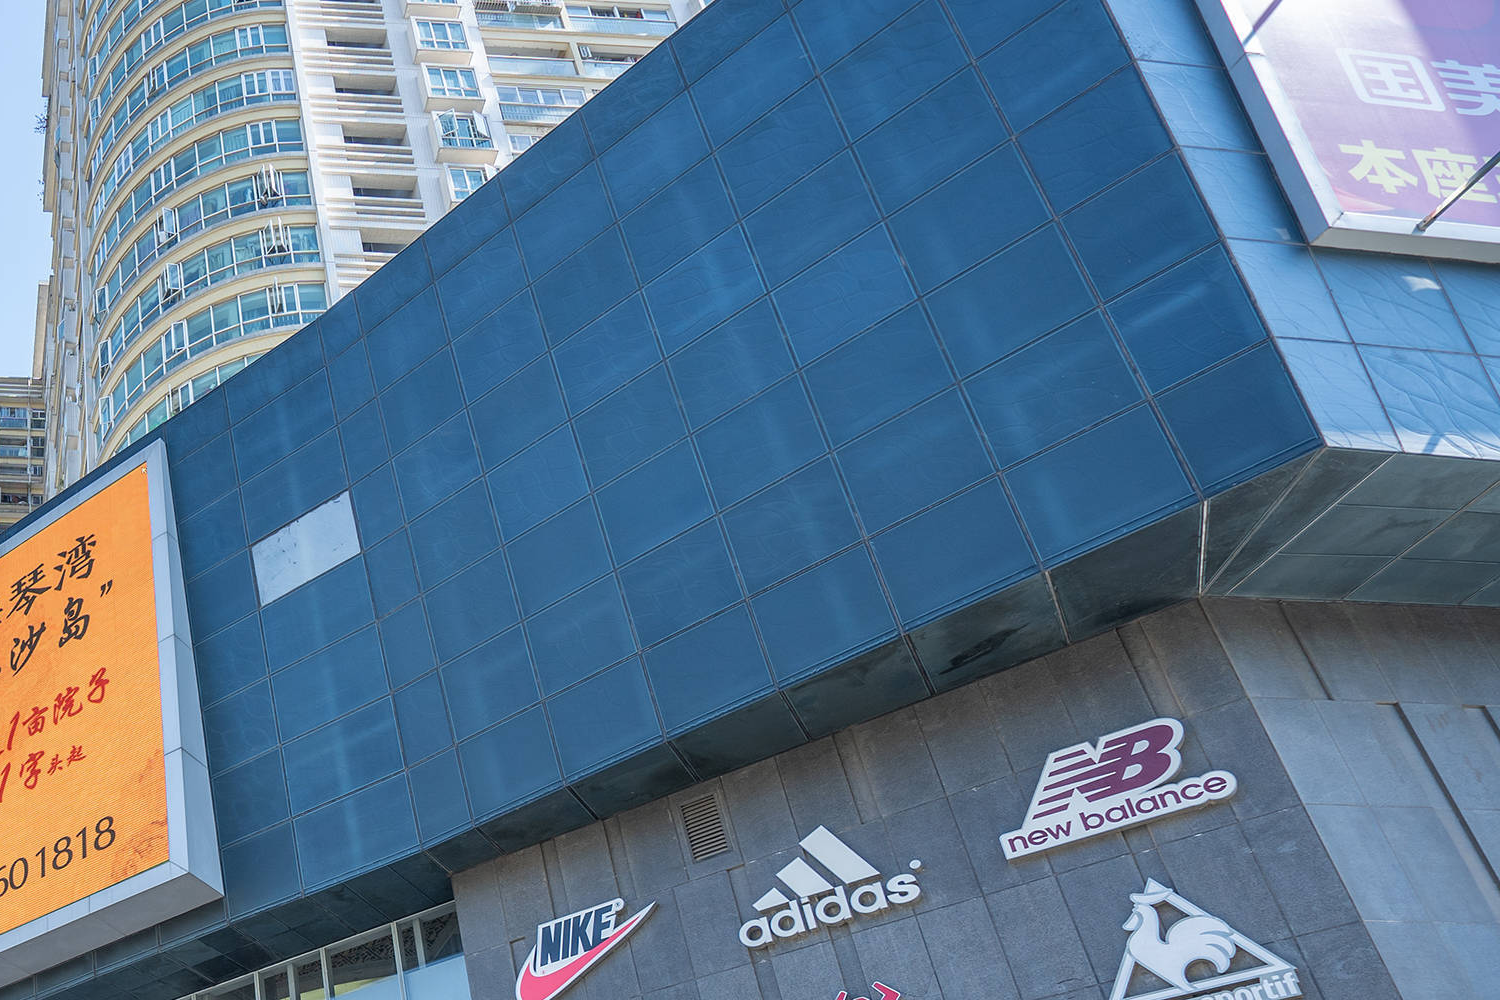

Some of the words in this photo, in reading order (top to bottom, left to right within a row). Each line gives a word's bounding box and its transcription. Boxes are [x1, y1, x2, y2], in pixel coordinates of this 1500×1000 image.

[1337, 139, 1500, 204] 本座
[1008, 820, 1072, 853] new
[1079, 776, 1228, 831] balance
[540, 903, 618, 967] NIKE
[739, 872, 922, 949] adidas
